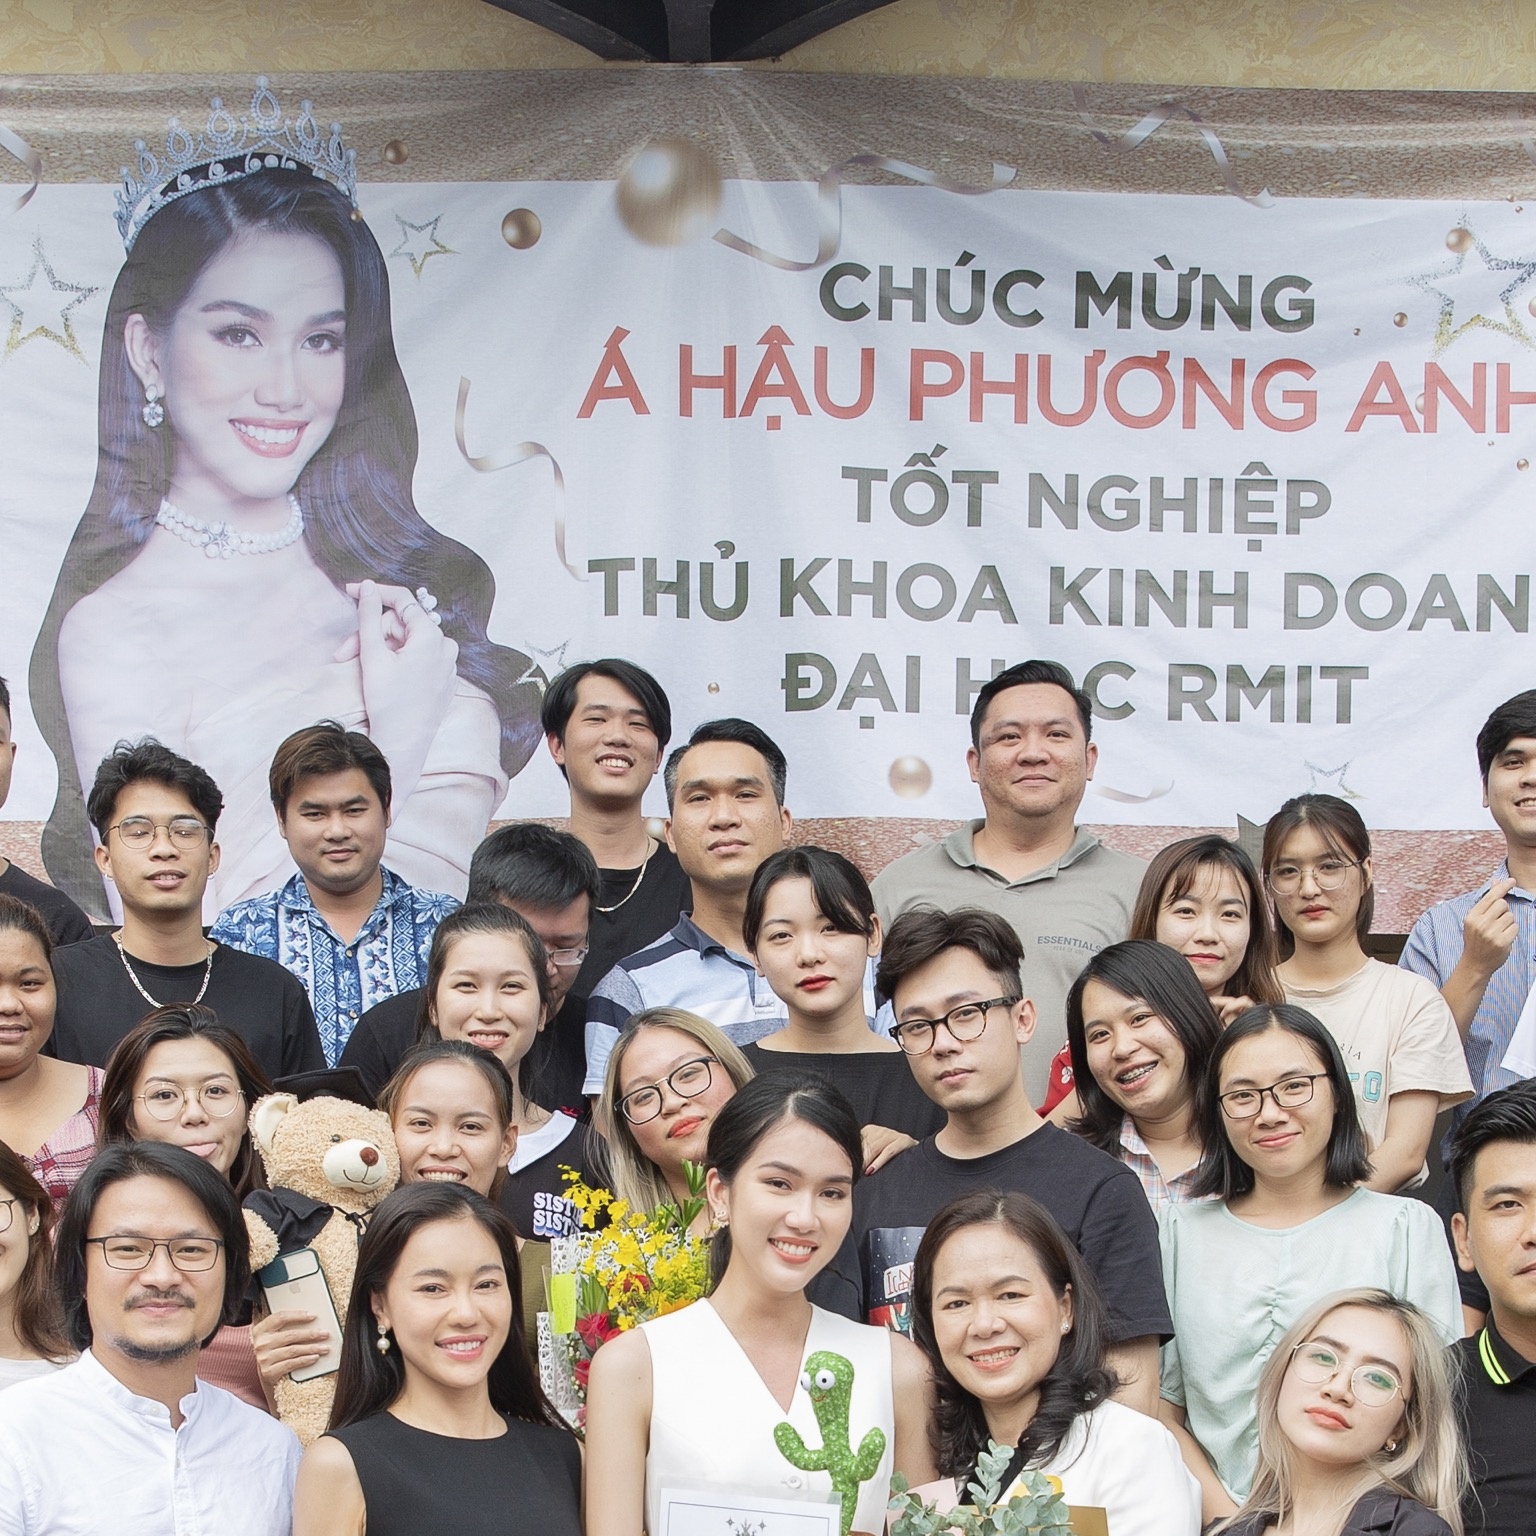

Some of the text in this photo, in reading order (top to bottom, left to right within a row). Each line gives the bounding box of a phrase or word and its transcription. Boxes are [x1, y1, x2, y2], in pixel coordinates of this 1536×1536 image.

[819, 250, 1315, 334] CHÚC MỪNG
[577, 325, 649, 419] Á
[679, 325, 875, 433] HẬU
[909, 345, 1317, 434] PHƯƠNG
[841, 443, 1332, 552] TỐT NGHIỆP
[587, 541, 749, 622] THỦ
[779, 557, 1019, 625] KHOA
[1048, 566, 1249, 629] KINH
[781, 653, 1369, 730] ĐẠI HC RMIT
[1038, 936, 1102, 953] ESSENTIALS
